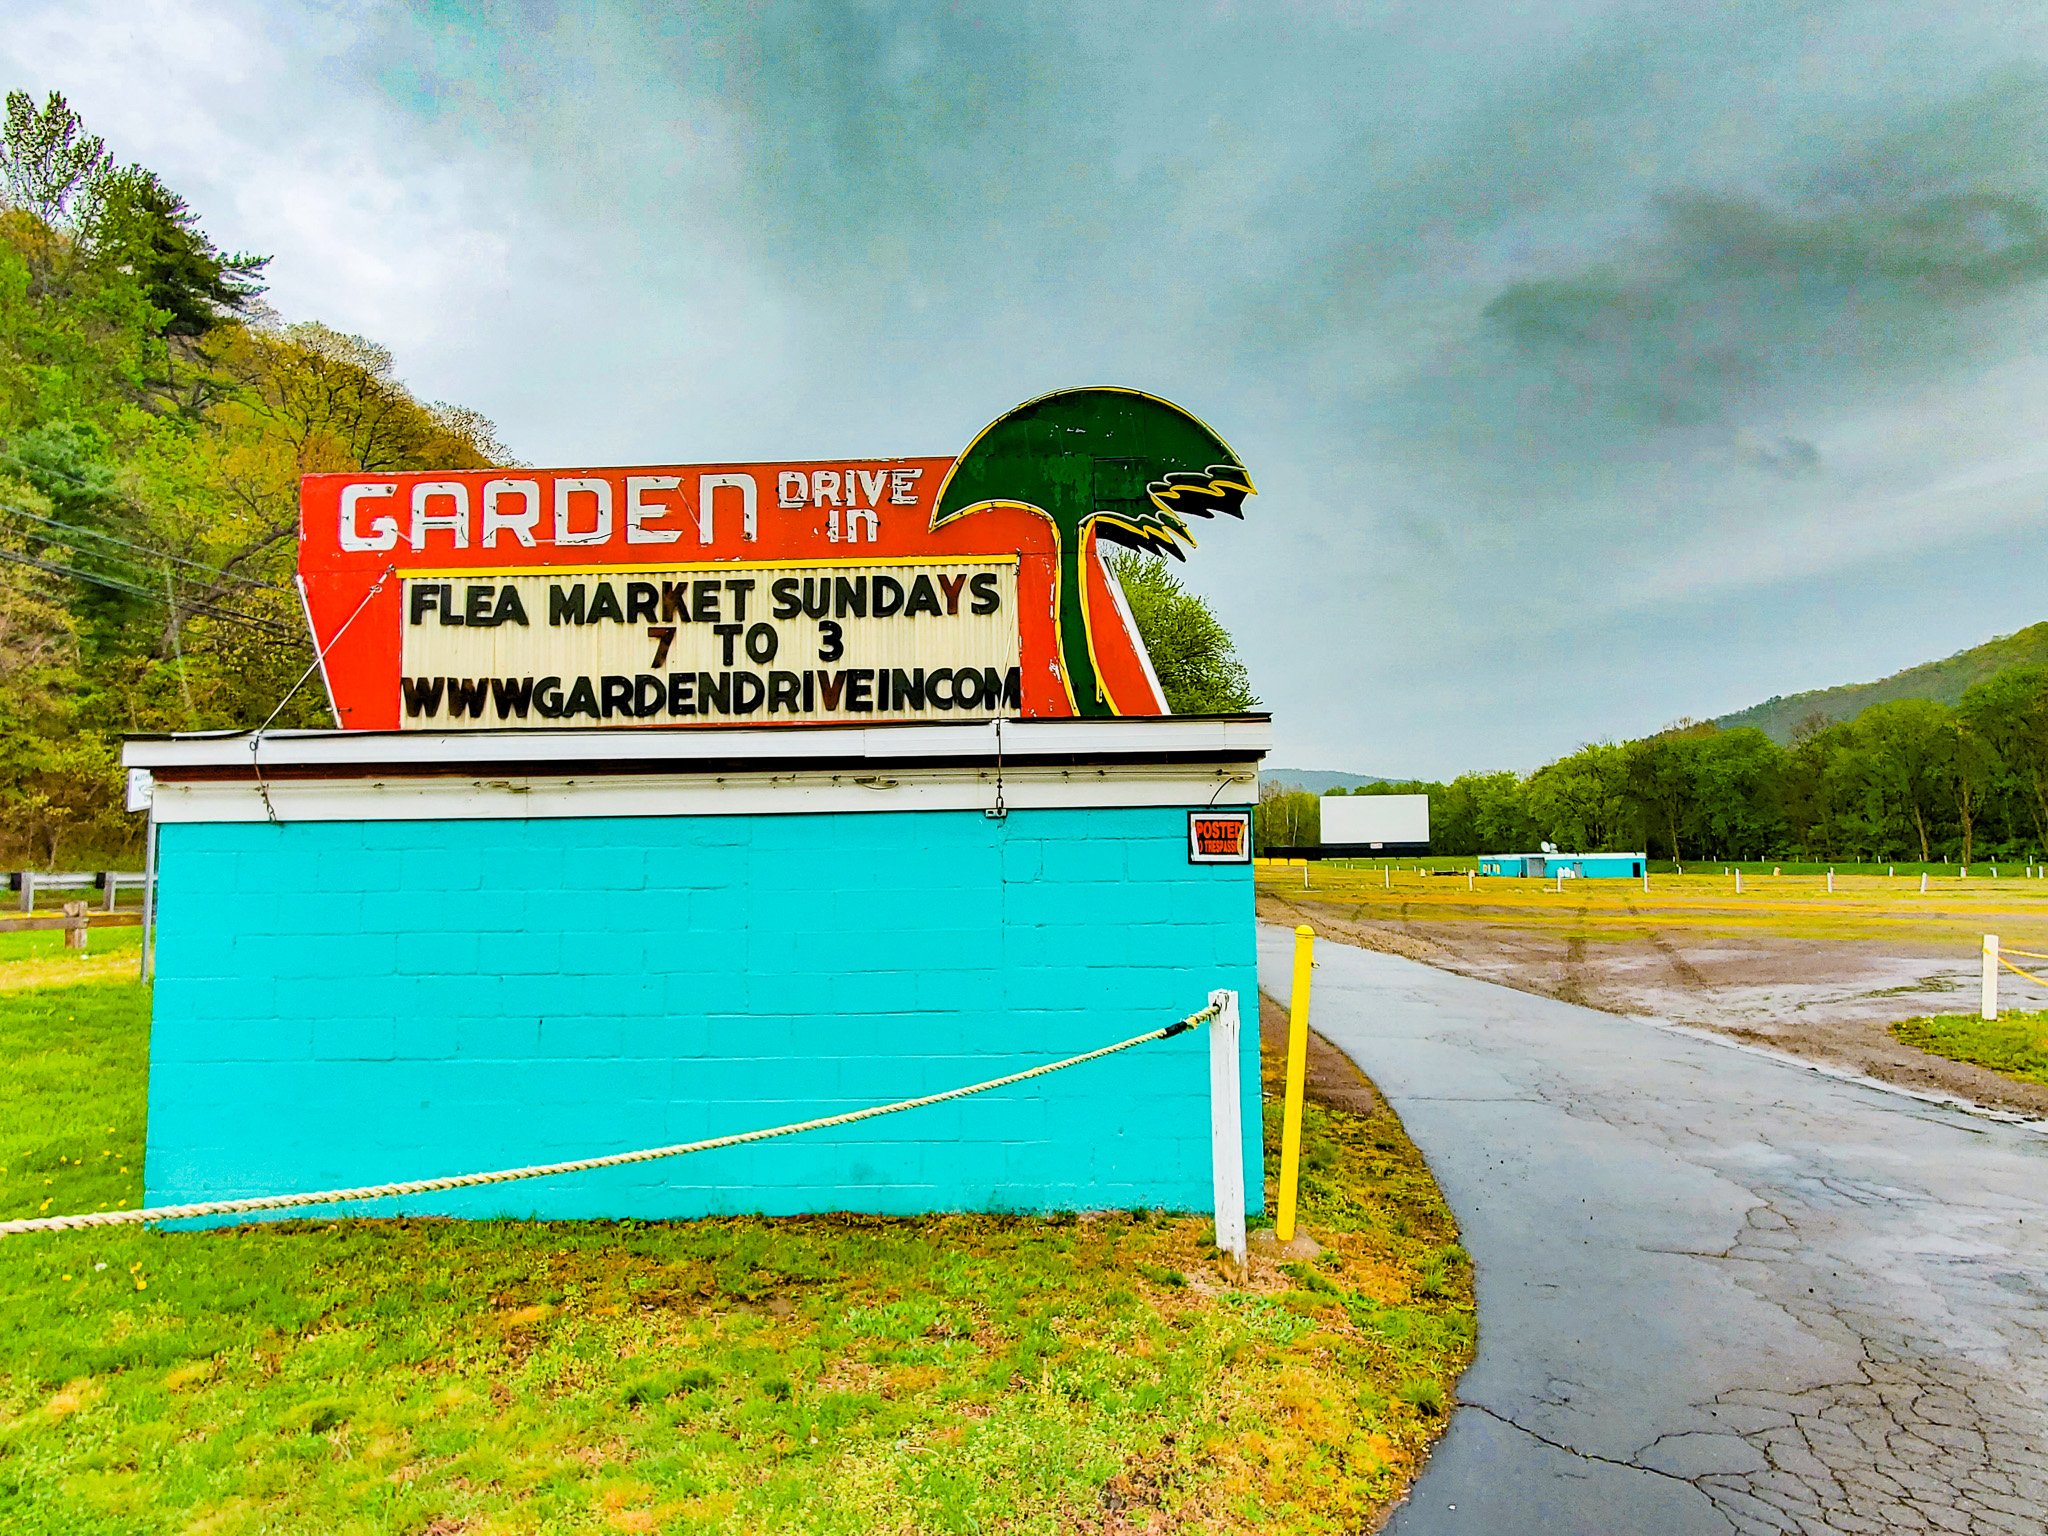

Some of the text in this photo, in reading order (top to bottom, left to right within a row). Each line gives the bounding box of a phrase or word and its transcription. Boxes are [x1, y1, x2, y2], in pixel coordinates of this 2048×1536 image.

[340, 468, 924, 552] GARDEN DRIVE
[410, 573, 1000, 626] FLEA MARKET SUNDAYS
[647, 620, 844, 668] 7 TO 3
